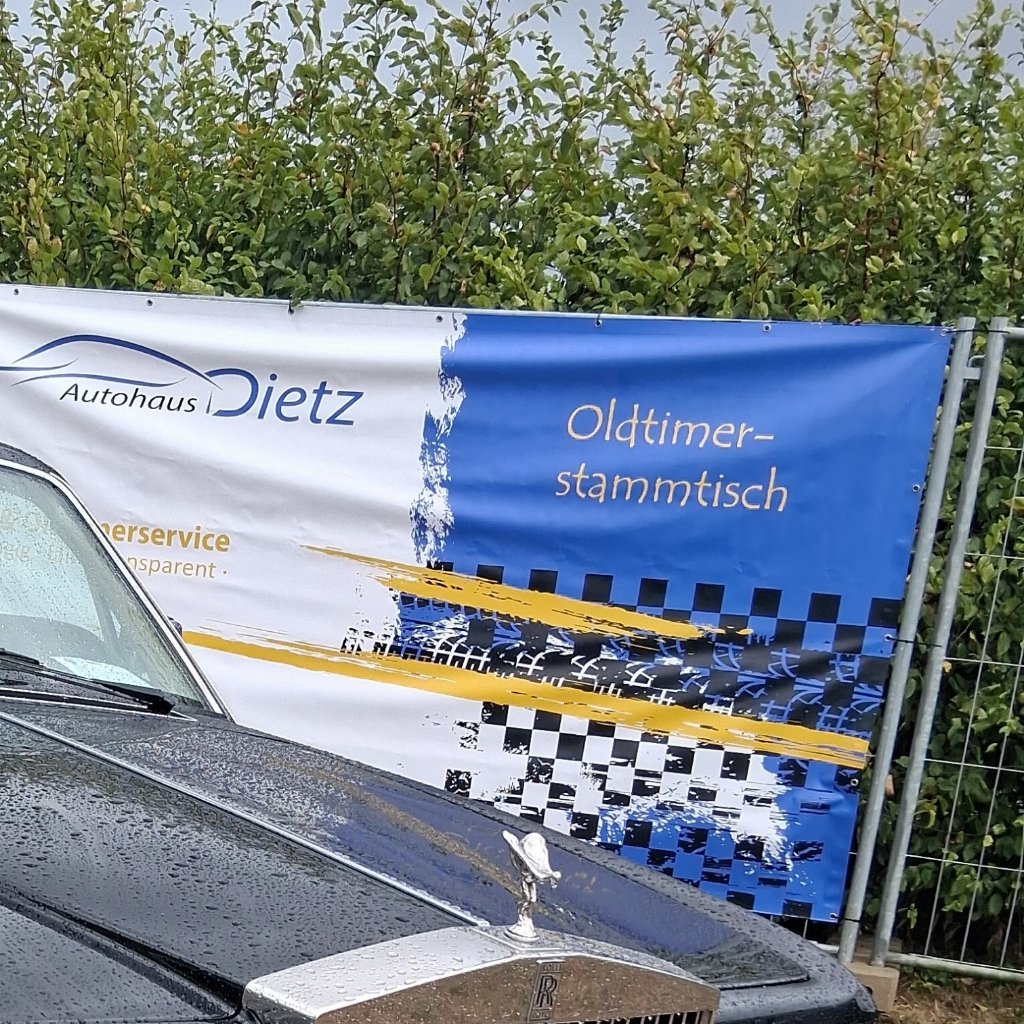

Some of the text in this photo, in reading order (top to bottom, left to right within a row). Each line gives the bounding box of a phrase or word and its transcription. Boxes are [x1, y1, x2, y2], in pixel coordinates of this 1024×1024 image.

[60, 367, 365, 426] Autohaus Dietz
[566, 398, 775, 449] Oldtimer-
[554, 463, 789, 512] stammtisch
